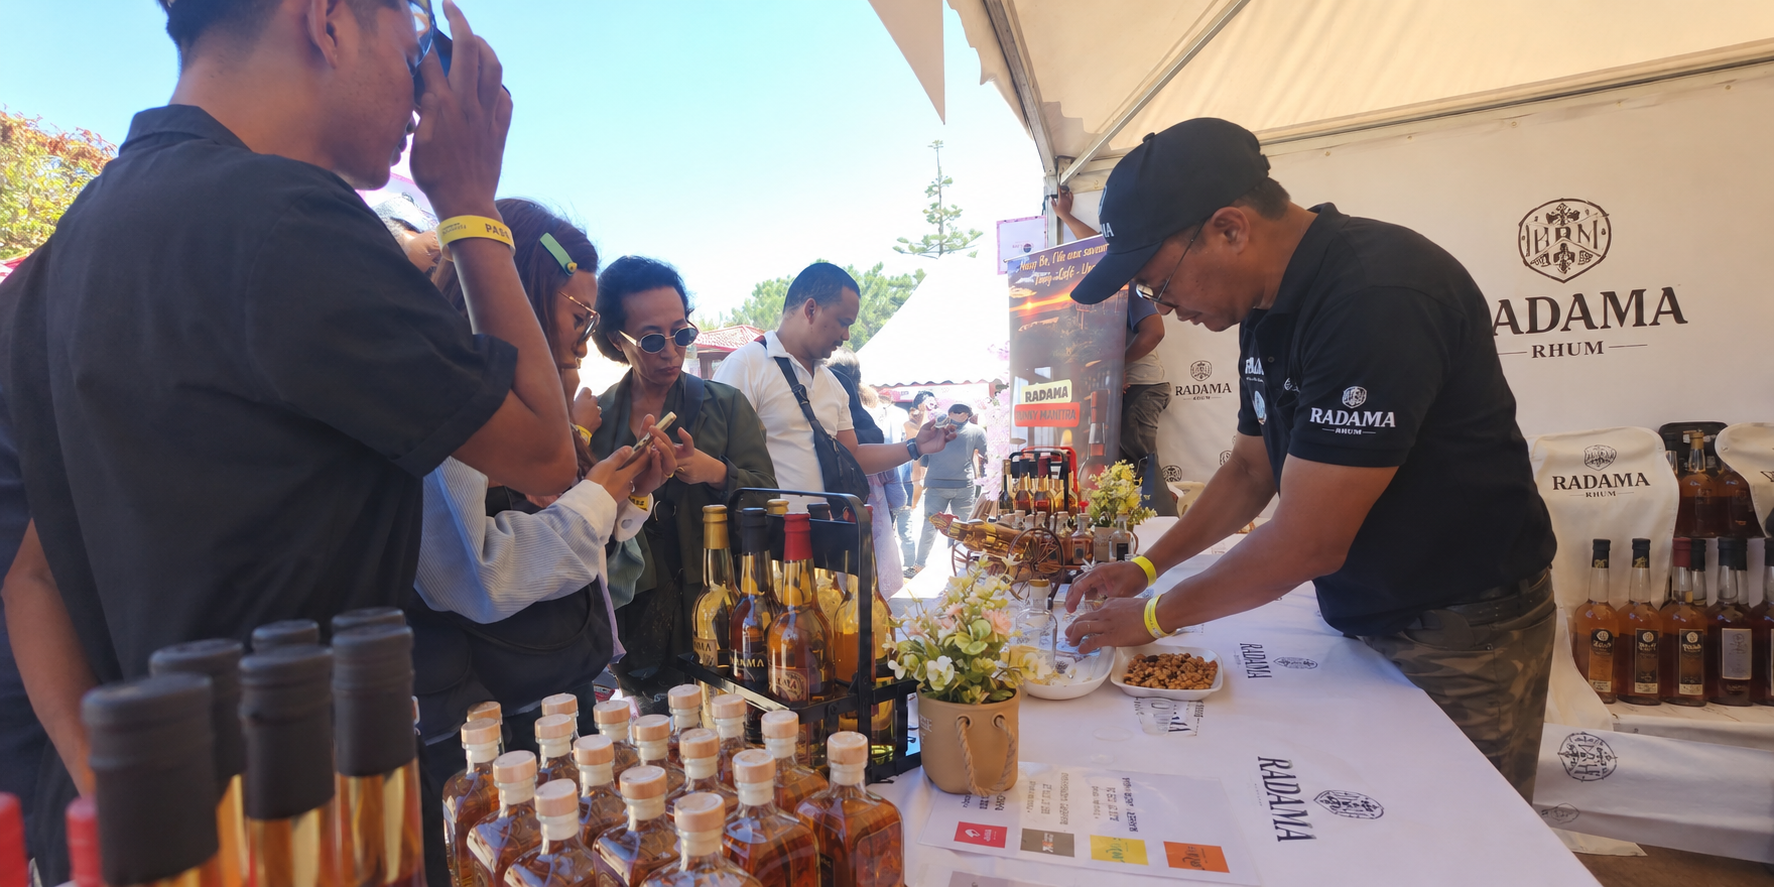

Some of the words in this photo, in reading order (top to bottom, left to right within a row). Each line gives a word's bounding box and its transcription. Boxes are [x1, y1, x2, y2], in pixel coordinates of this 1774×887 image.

[1493, 286, 1689, 336] ADAMA
[1532, 341, 1604, 358] RHUM
[1025, 386, 1068, 402] RADAMA
[1175, 382, 1232, 396] RADAMA
[1309, 407, 1396, 428] RADAMA
[1552, 472, 1651, 490] RADAMA
[1585, 490, 1617, 498] RHUM
[1239, 642, 1272, 679] RADAMA
[1257, 756, 1318, 843] RADAMA
